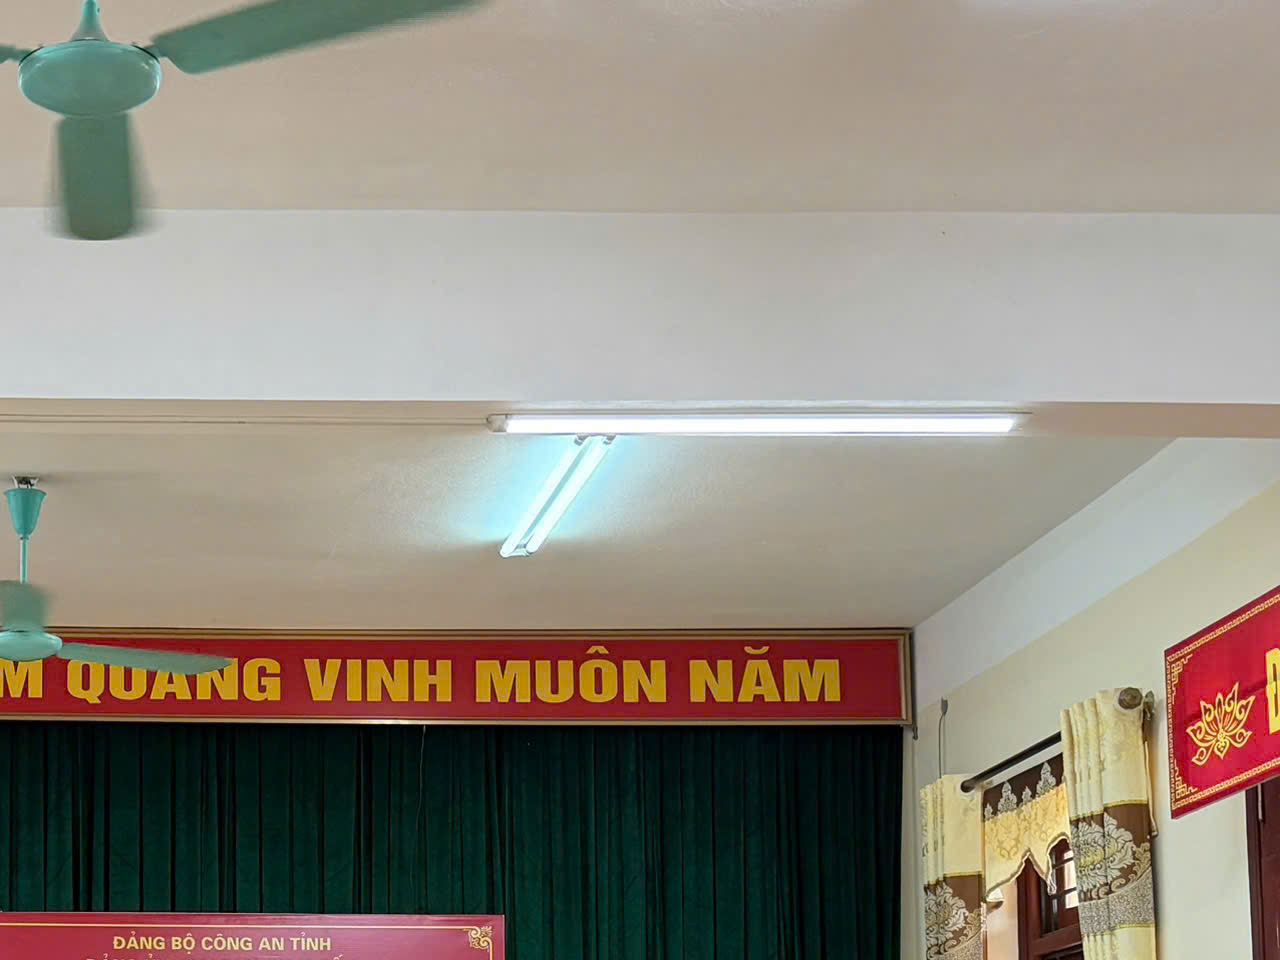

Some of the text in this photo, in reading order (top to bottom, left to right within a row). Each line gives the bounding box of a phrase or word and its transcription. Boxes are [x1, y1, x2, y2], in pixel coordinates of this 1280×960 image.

[67, 655, 281, 704] QUANG
[304, 658, 452, 703] VINH
[475, 645, 667, 703] MUÔN
[689, 645, 841, 703] NĂM
[113, 932, 331, 954] ĐẢNG BỘ CÔNG AN TỈNH
